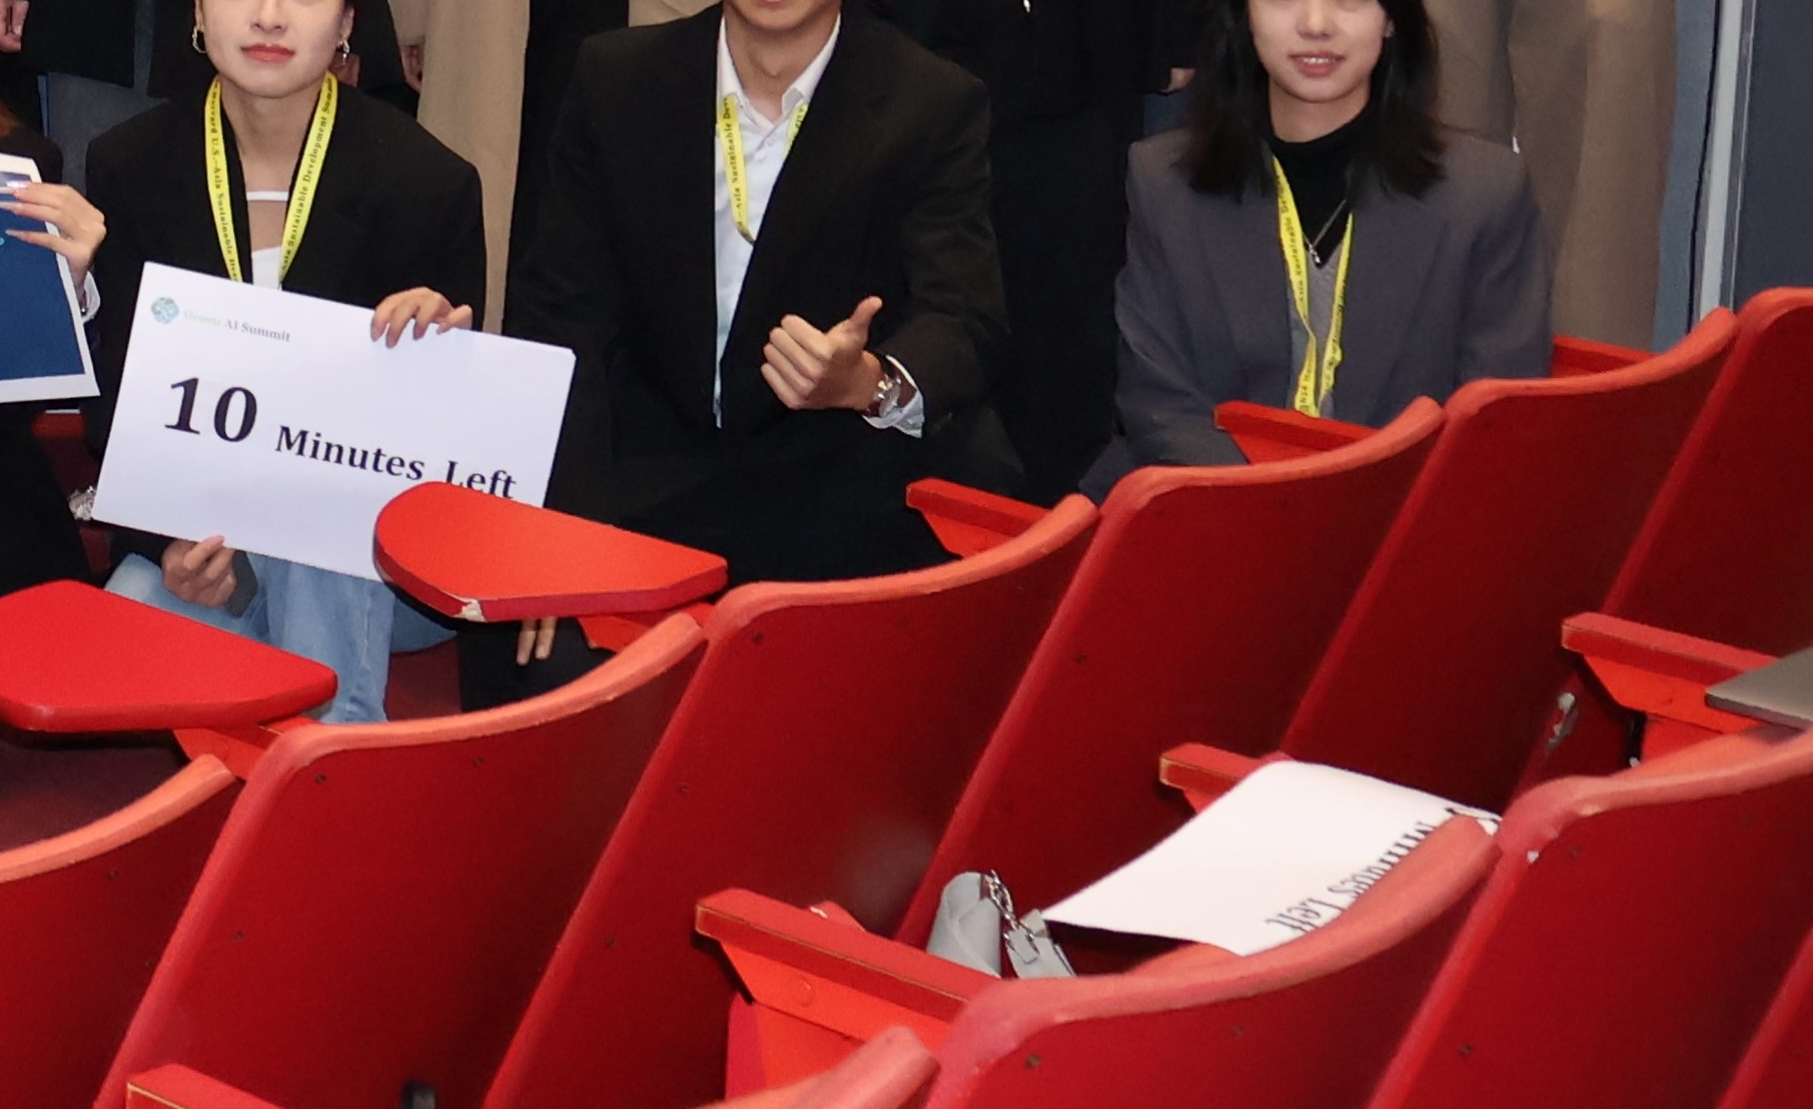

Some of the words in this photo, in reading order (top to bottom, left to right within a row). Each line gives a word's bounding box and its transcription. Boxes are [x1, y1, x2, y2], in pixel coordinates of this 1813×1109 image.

[288, 187, 308, 249] Sustainable
[302, 115, 328, 182] Development
[723, 122, 738, 184] Sustainable
[216, 193, 233, 255] Sustainable
[183, 307, 222, 328] Green
[224, 318, 239, 331] AI
[240, 321, 291, 343] Summit
[164, 376, 258, 443] 10
[274, 424, 426, 481] Minutes
[443, 459, 517, 500] Left
